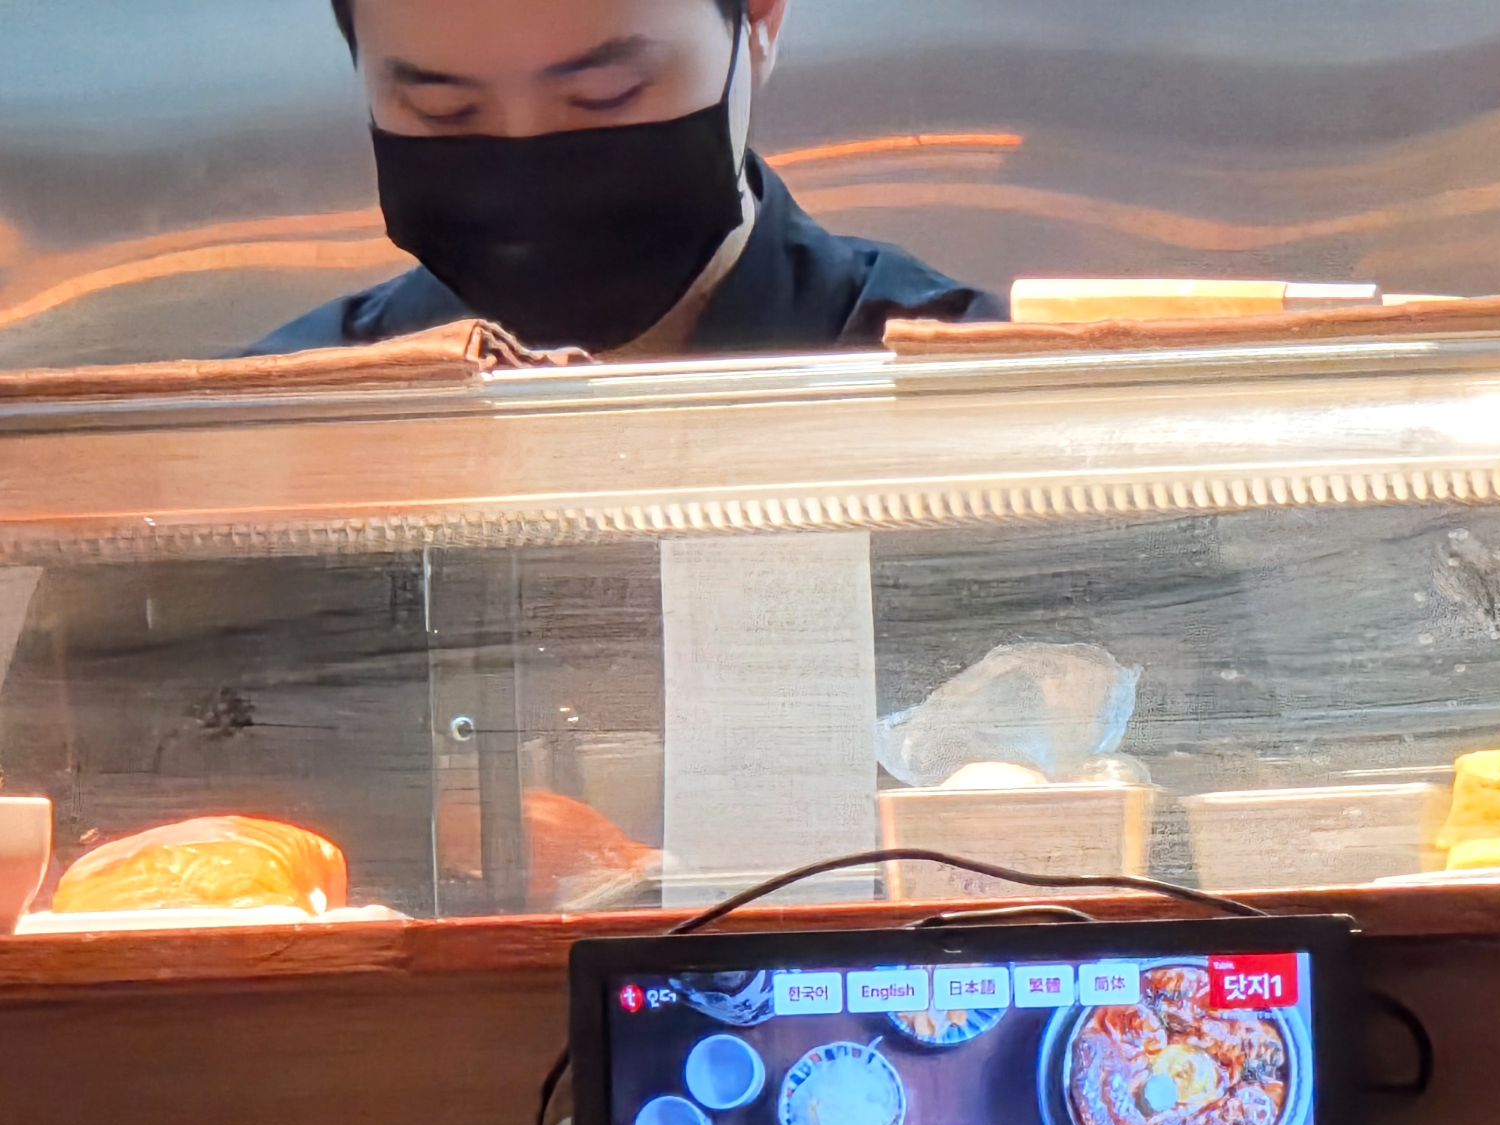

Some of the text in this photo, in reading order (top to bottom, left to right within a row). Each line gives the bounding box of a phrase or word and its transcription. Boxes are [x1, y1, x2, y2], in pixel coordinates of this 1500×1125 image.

[788, 985, 829, 1002] 한국어
[861, 984, 915, 1000] English
[949, 979, 996, 997] 日本語
[1223, 972, 1283, 1001] 닷지1
